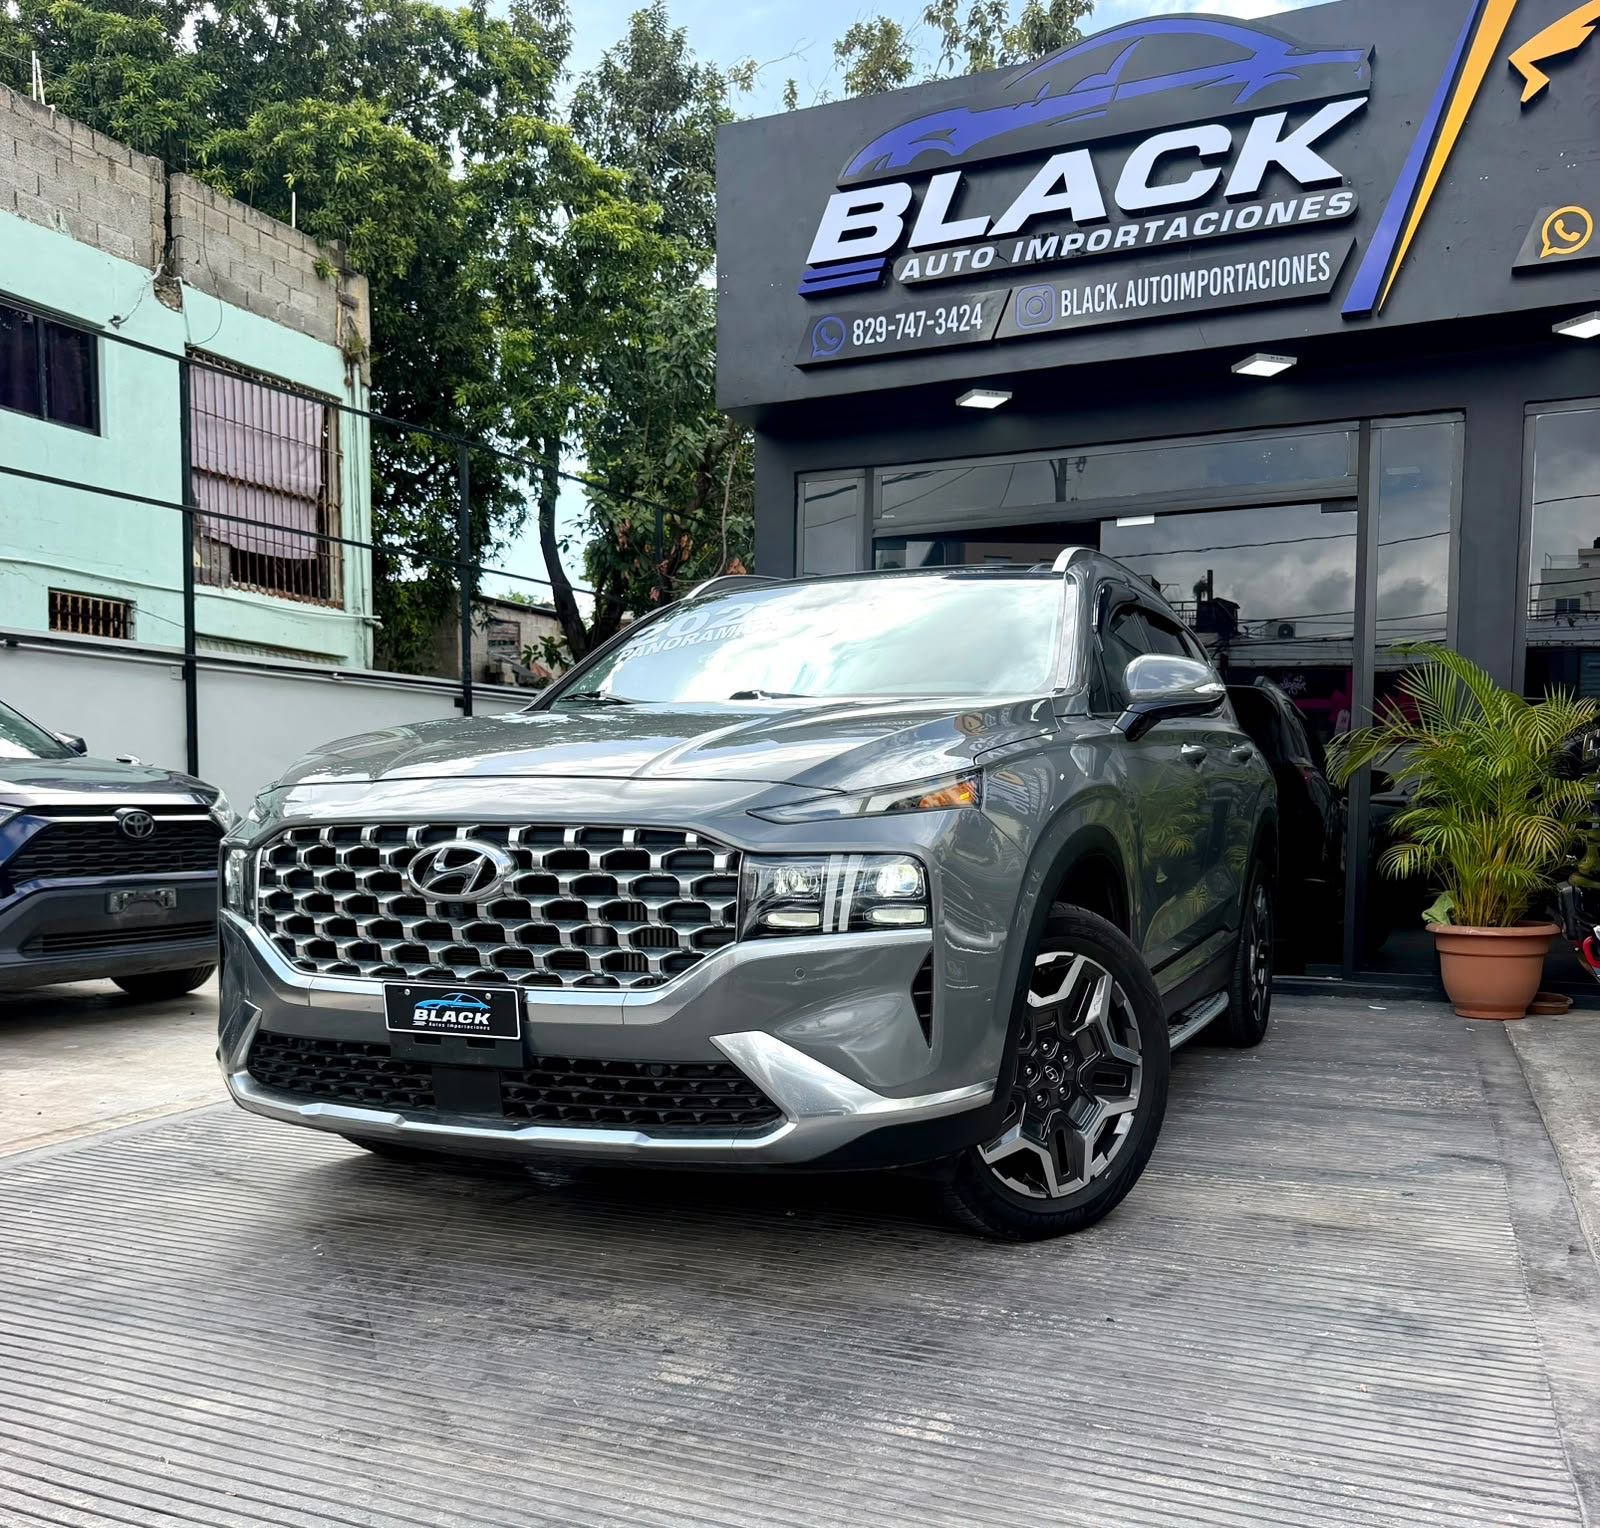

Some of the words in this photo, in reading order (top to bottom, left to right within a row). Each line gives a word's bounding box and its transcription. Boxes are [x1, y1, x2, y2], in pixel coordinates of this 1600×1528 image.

[805, 97, 1368, 265] BLACK
[898, 246, 995, 282] AUTO
[1011, 190, 1356, 263] IMPORTACIONES
[1060, 251, 1332, 318] BLACK.AUTOIMPORTACIONES
[851, 303, 983, 346] 829-747-3424
[621, 602, 758, 650] 202
[413, 1008, 491, 1025] BLACK
